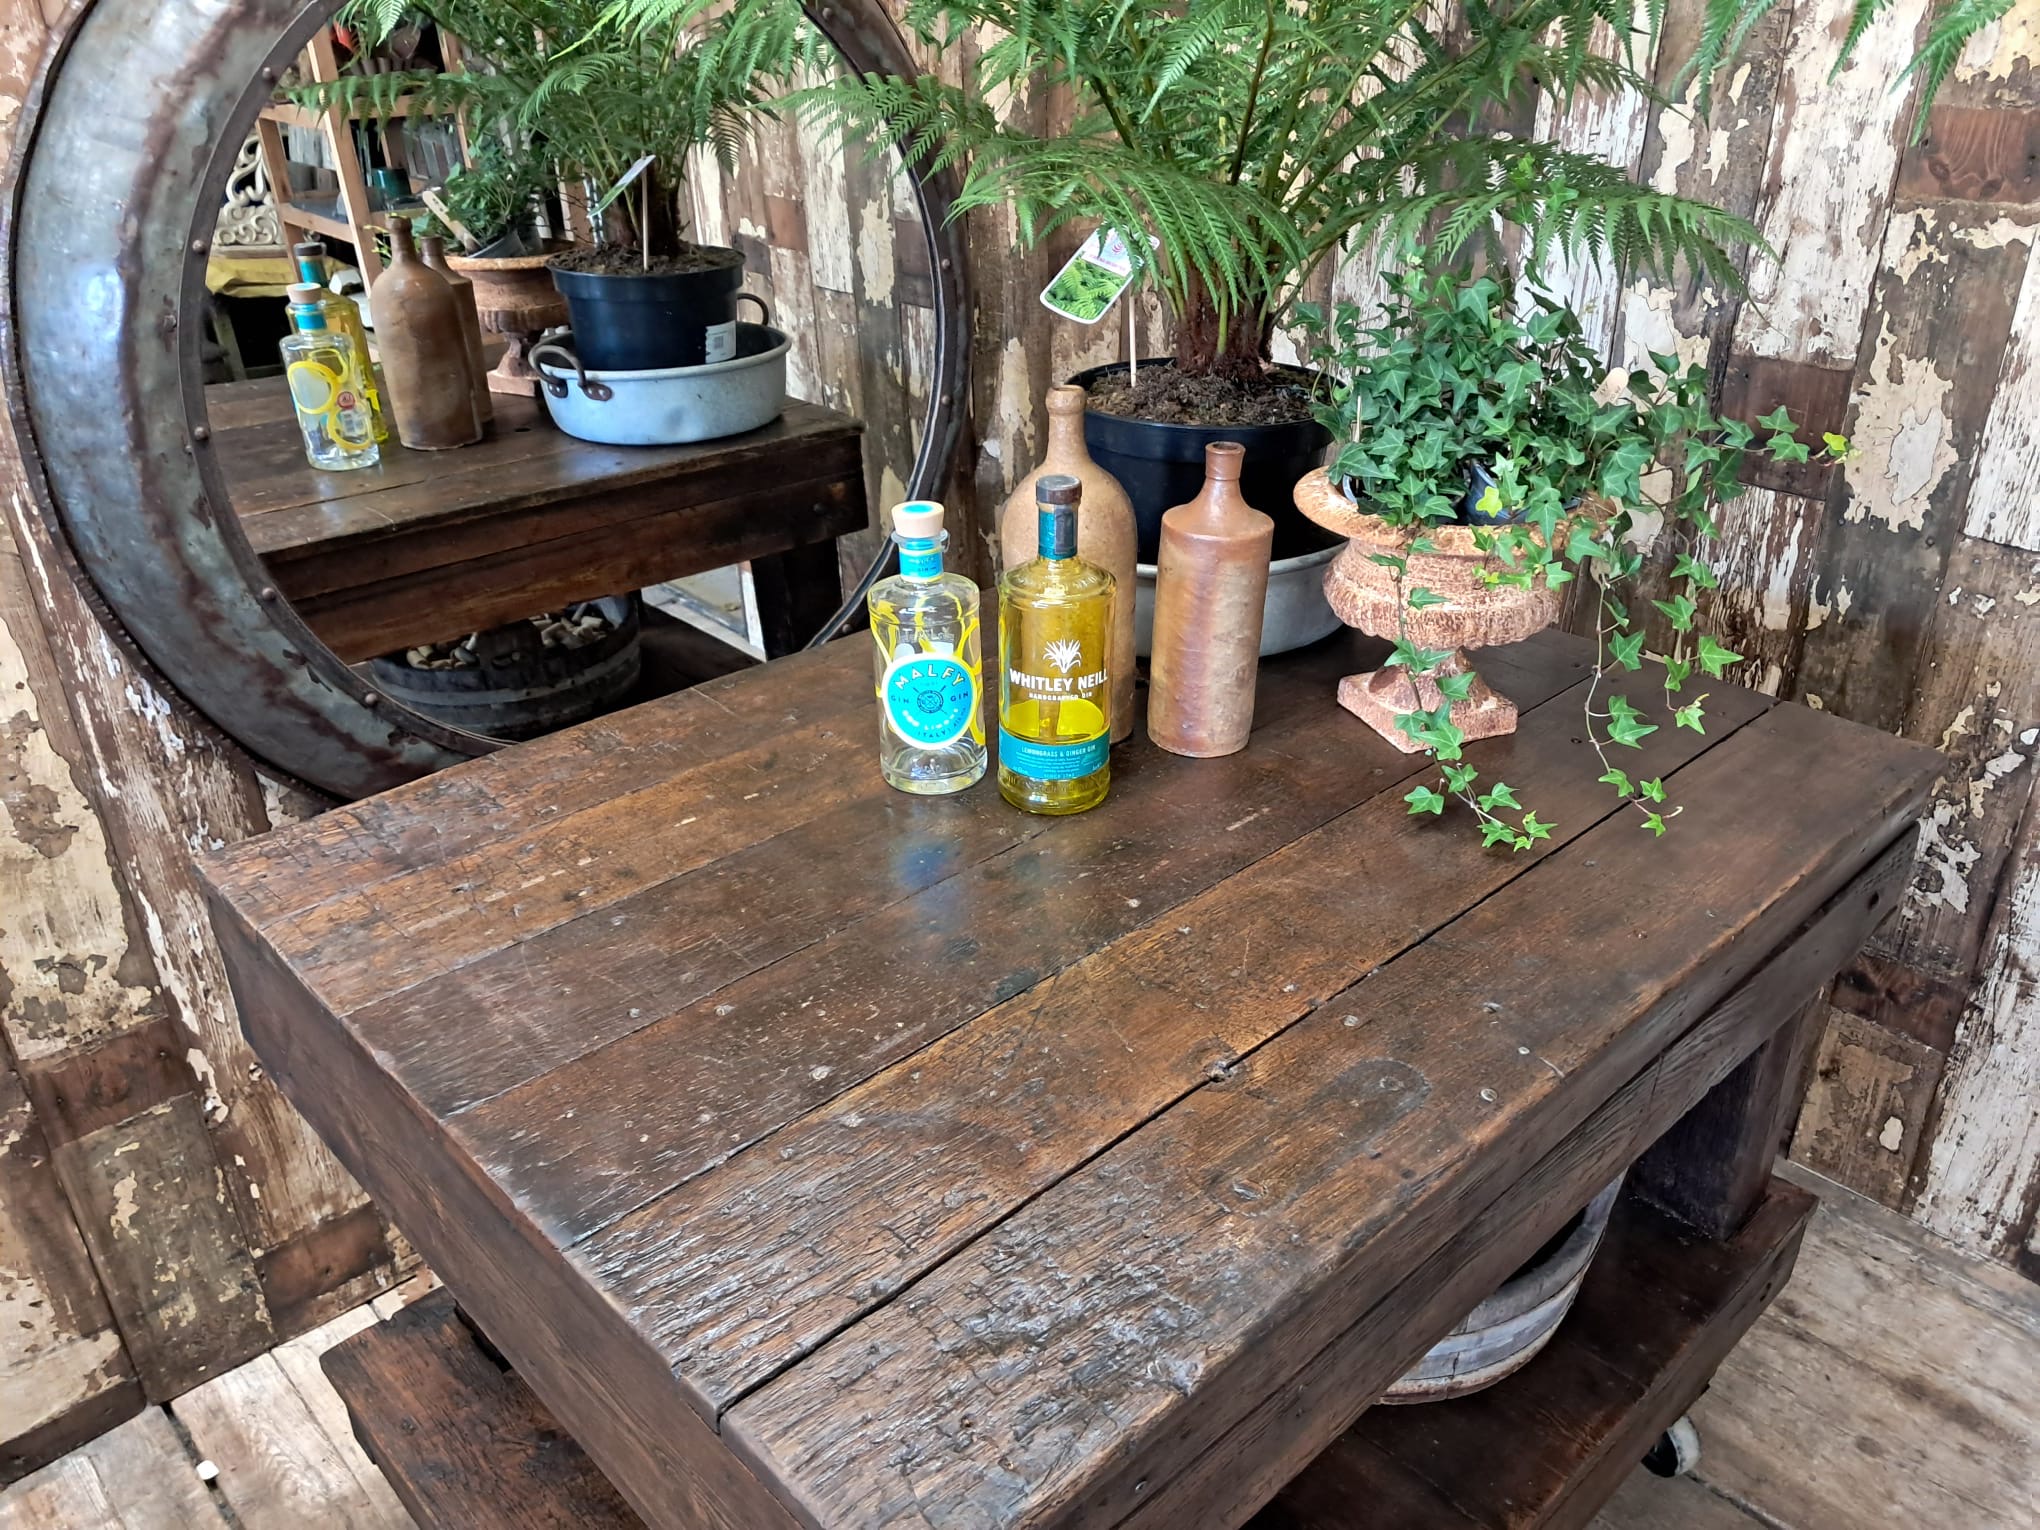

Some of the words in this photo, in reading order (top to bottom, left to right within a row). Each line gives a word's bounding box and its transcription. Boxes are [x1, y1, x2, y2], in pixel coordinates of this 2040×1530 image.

[895, 664, 964, 690] MALFY
[1009, 667, 1073, 692] WHITLEY
[1077, 667, 1108, 690] NEILL
[890, 694, 909, 704] GIN
[950, 691, 968, 702] GIN
